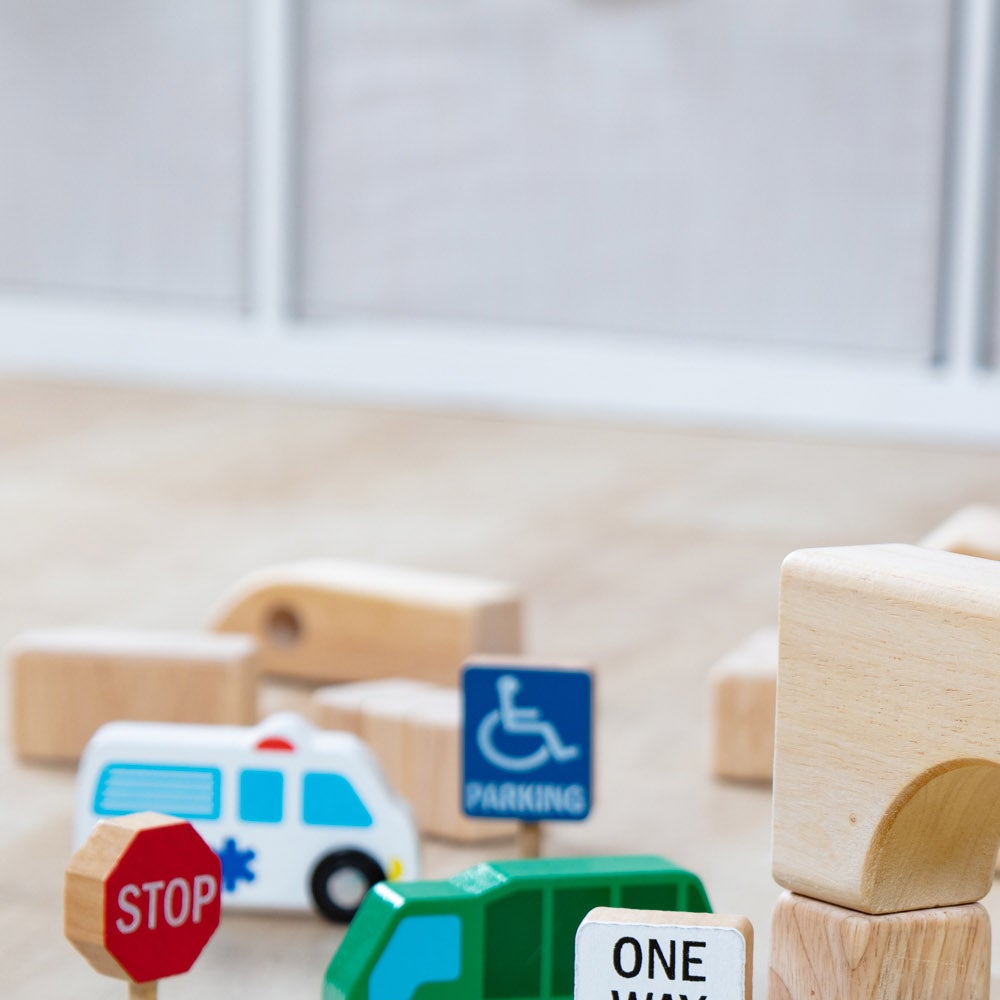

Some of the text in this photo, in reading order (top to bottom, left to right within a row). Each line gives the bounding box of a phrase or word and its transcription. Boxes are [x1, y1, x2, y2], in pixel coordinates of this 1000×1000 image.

[466, 780, 586, 815] PARKING
[116, 875, 219, 935] STOP
[613, 936, 708, 983] ONE
